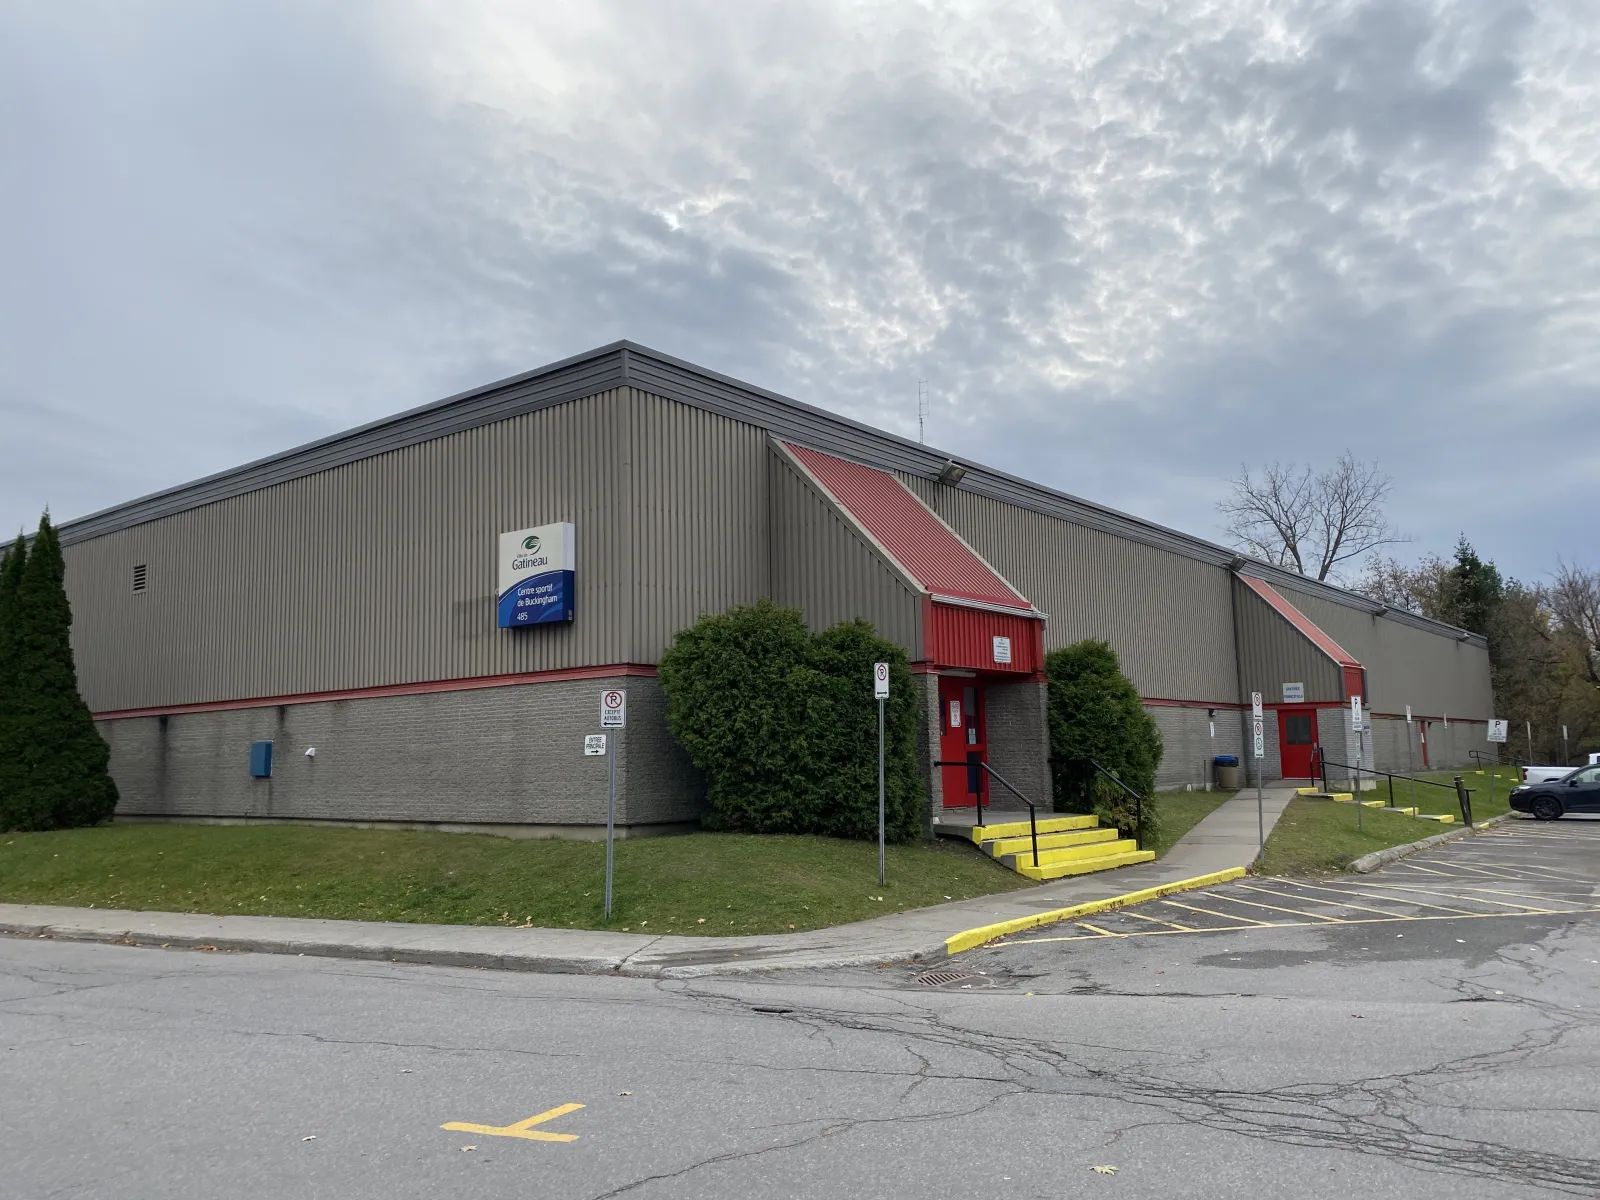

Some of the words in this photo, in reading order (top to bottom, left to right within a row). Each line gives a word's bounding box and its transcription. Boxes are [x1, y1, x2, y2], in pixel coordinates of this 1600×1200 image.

[512, 556, 548, 570] Gatineau
[518, 587, 534, 596] Centre
[535, 584, 552, 595] sportif
[525, 596, 558, 606] Buckingham
[517, 612, 528, 620] 485
